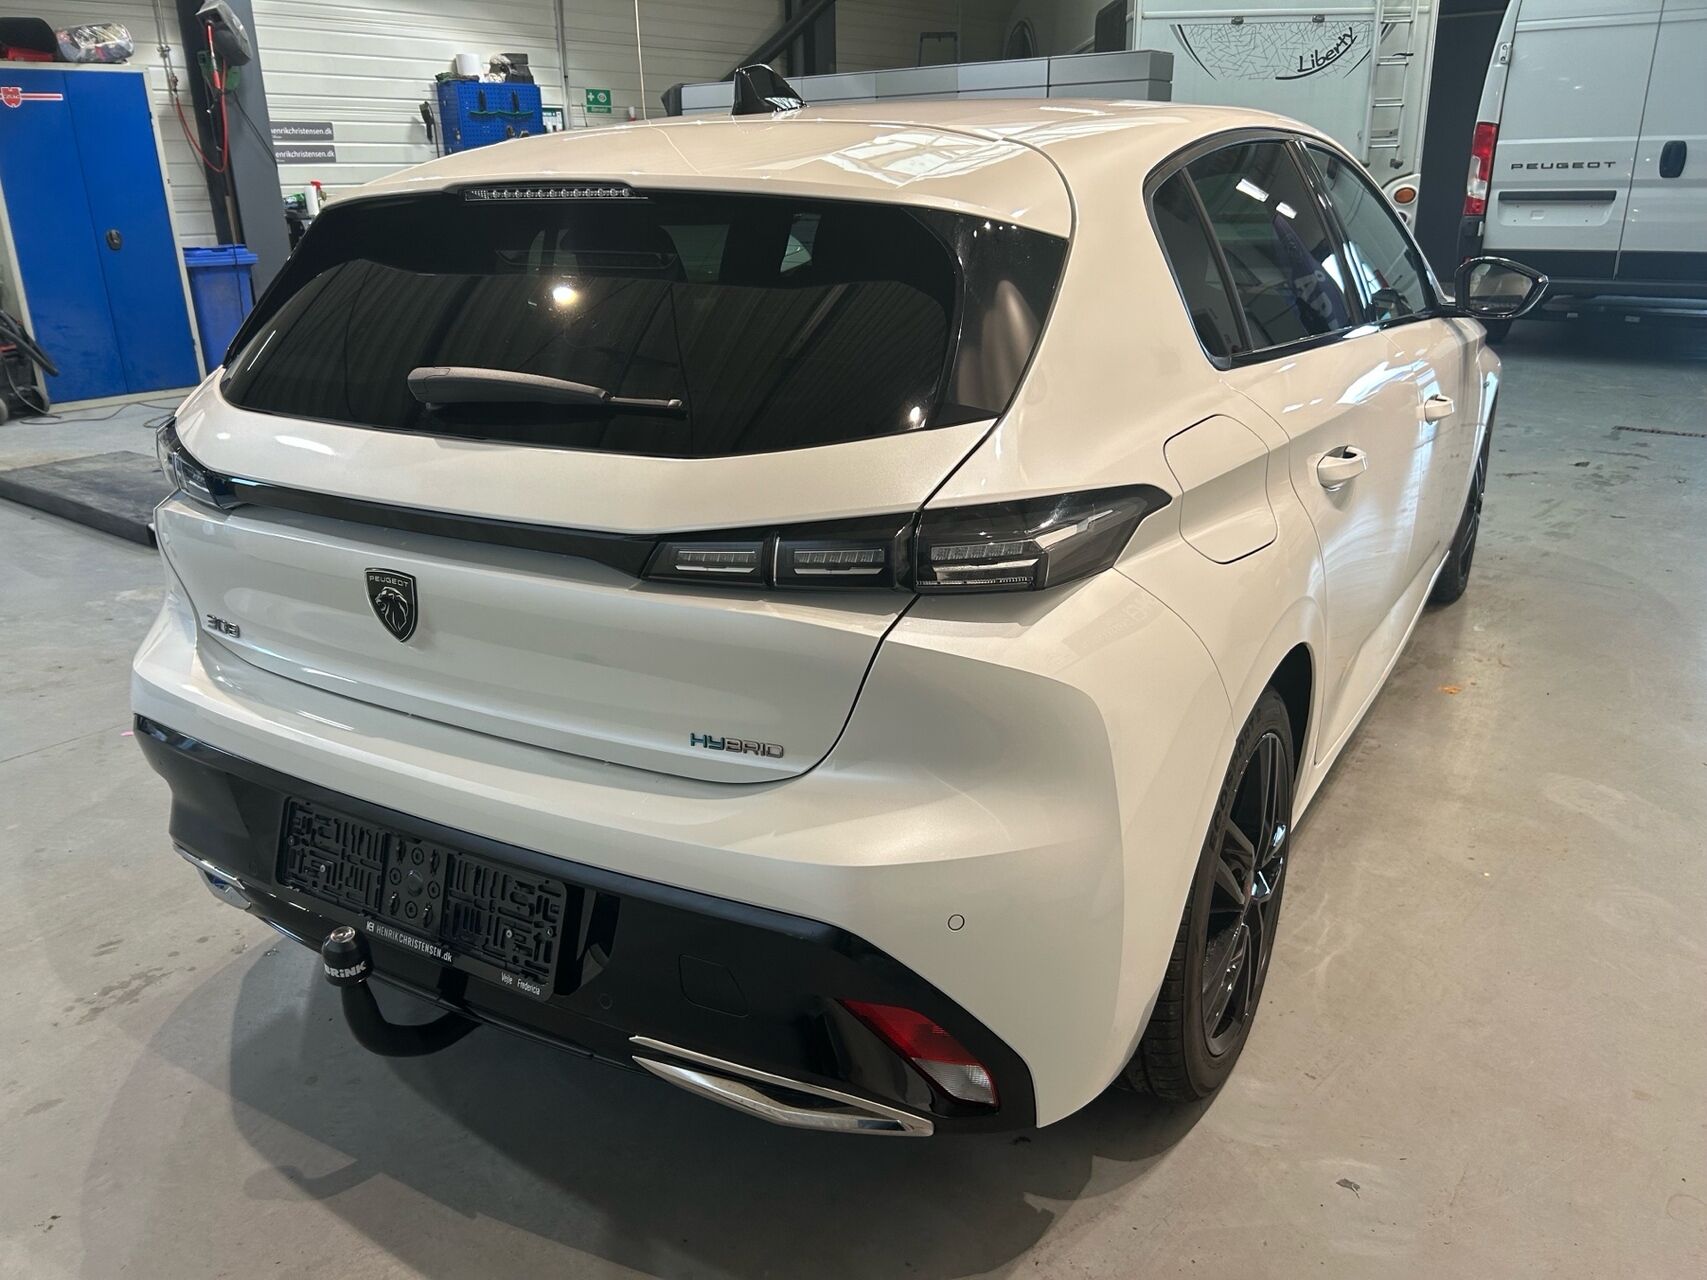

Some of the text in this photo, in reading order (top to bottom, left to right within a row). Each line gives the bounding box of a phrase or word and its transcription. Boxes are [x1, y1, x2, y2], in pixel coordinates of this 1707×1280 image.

[1297, 26, 1354, 72] Liberty
[275, 150, 335, 158] enrikchristensen.dk
[1510, 161, 1616, 170] PEUGEOT
[369, 575, 409, 587] PEUGEOT
[206, 614, 240, 638] 308
[690, 732, 784, 758] HYBRID
[376, 924, 452, 962] HENRIKCHRISTENSEN.dk
[517, 978, 541, 996] Fredericia
